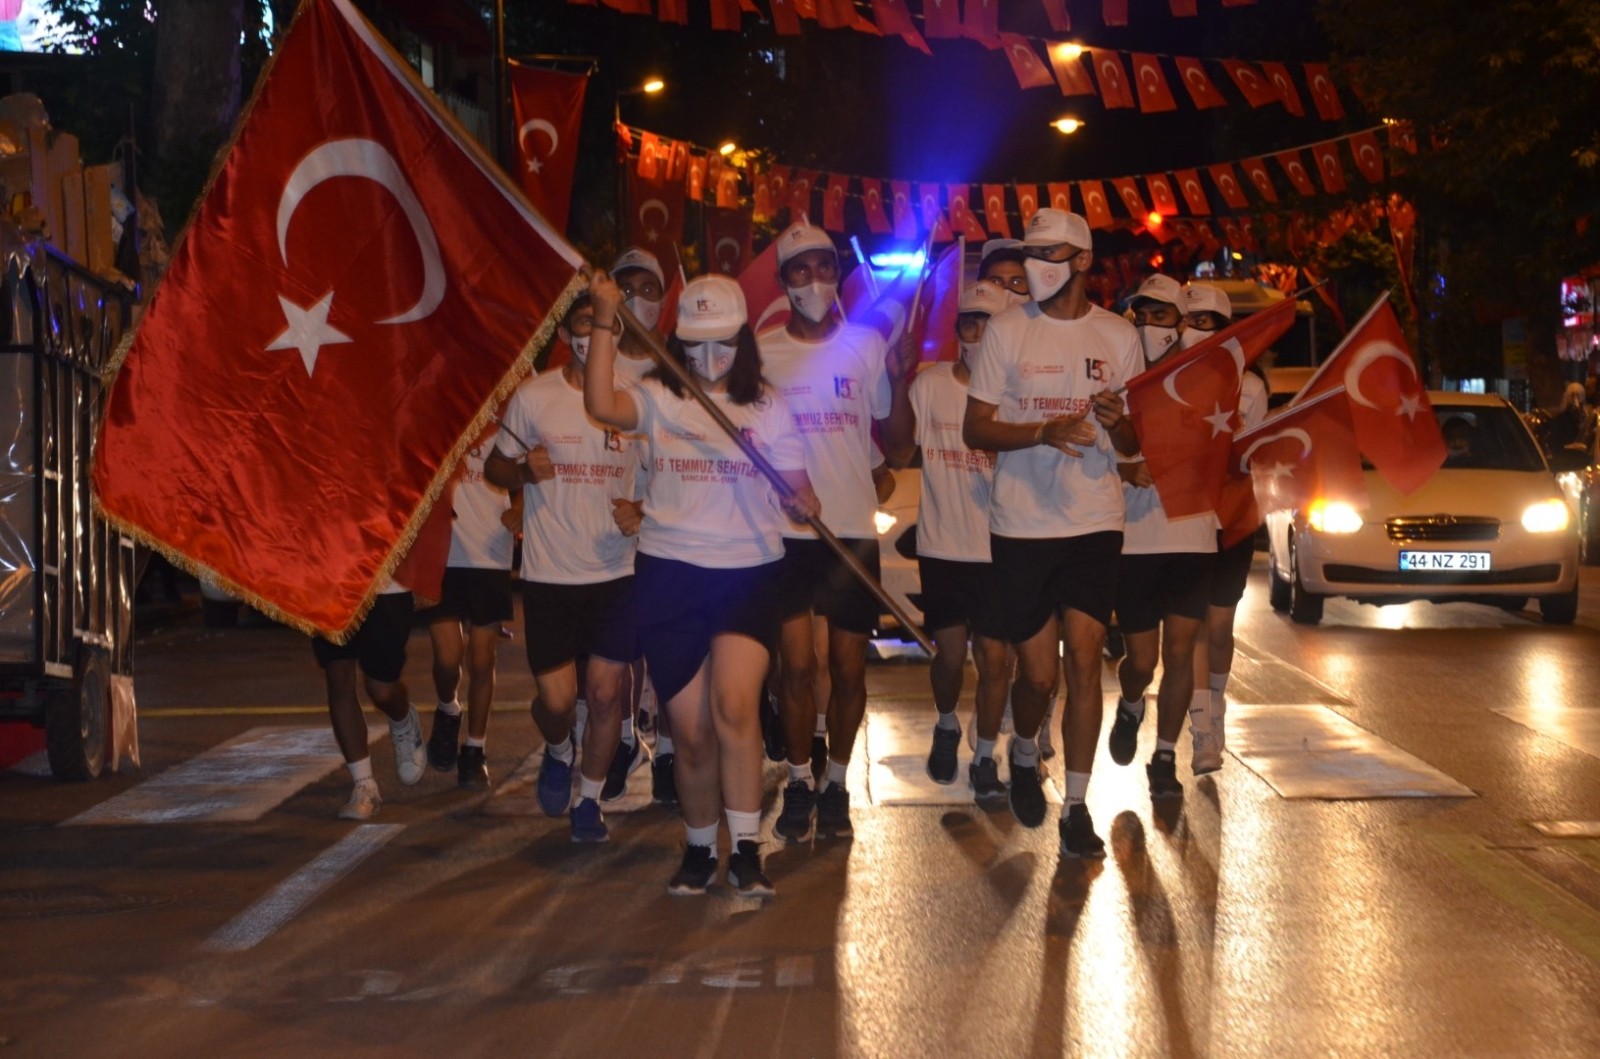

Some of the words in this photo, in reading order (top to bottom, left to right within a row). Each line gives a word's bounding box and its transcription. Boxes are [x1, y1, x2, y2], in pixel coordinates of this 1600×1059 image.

[1085, 358, 1105, 382] 15
[834, 377, 853, 399] 15
[1019, 398, 1029, 410] 15
[1033, 397, 1072, 410] TEMMUZ
[604, 430, 623, 452] 15
[669, 459, 714, 474] TEMMUZ
[1409, 554, 1428, 568] 44
[1432, 554, 1453, 568] NZ
[1460, 554, 1486, 568] 291
